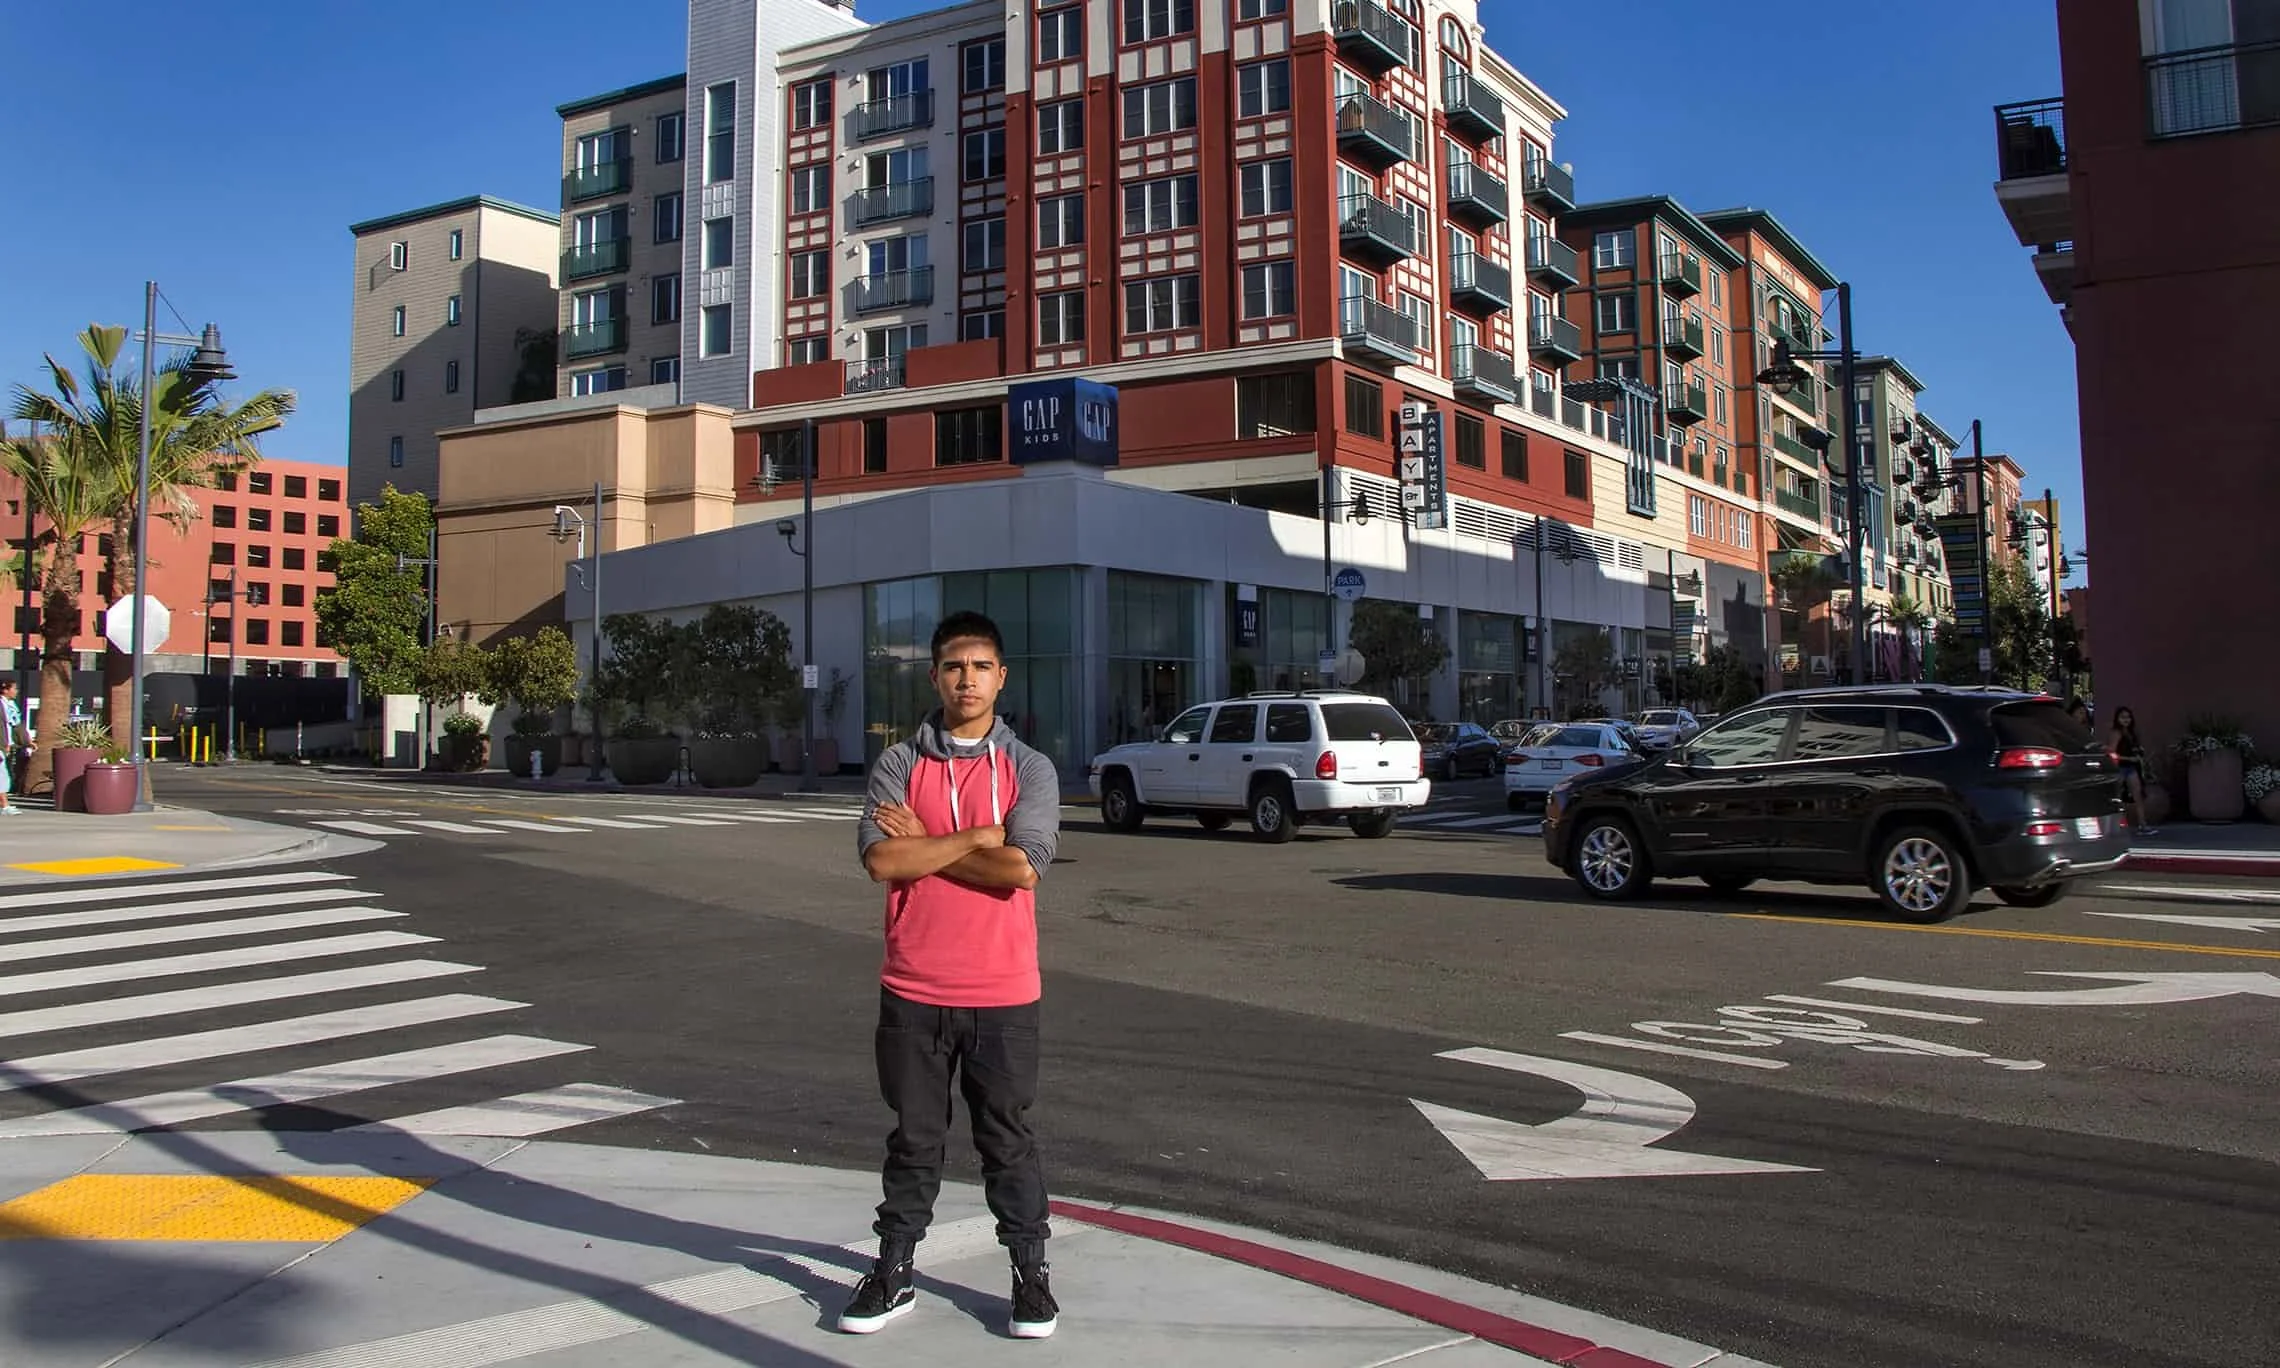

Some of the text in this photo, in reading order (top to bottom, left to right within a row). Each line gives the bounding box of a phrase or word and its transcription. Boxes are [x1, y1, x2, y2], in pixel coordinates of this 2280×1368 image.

[1023, 397, 1059, 431] GAP
[1083, 401, 1110, 442] GAP
[1024, 433, 1059, 444] KIDS
[1428, 417, 1438, 509] APARTMENTS
